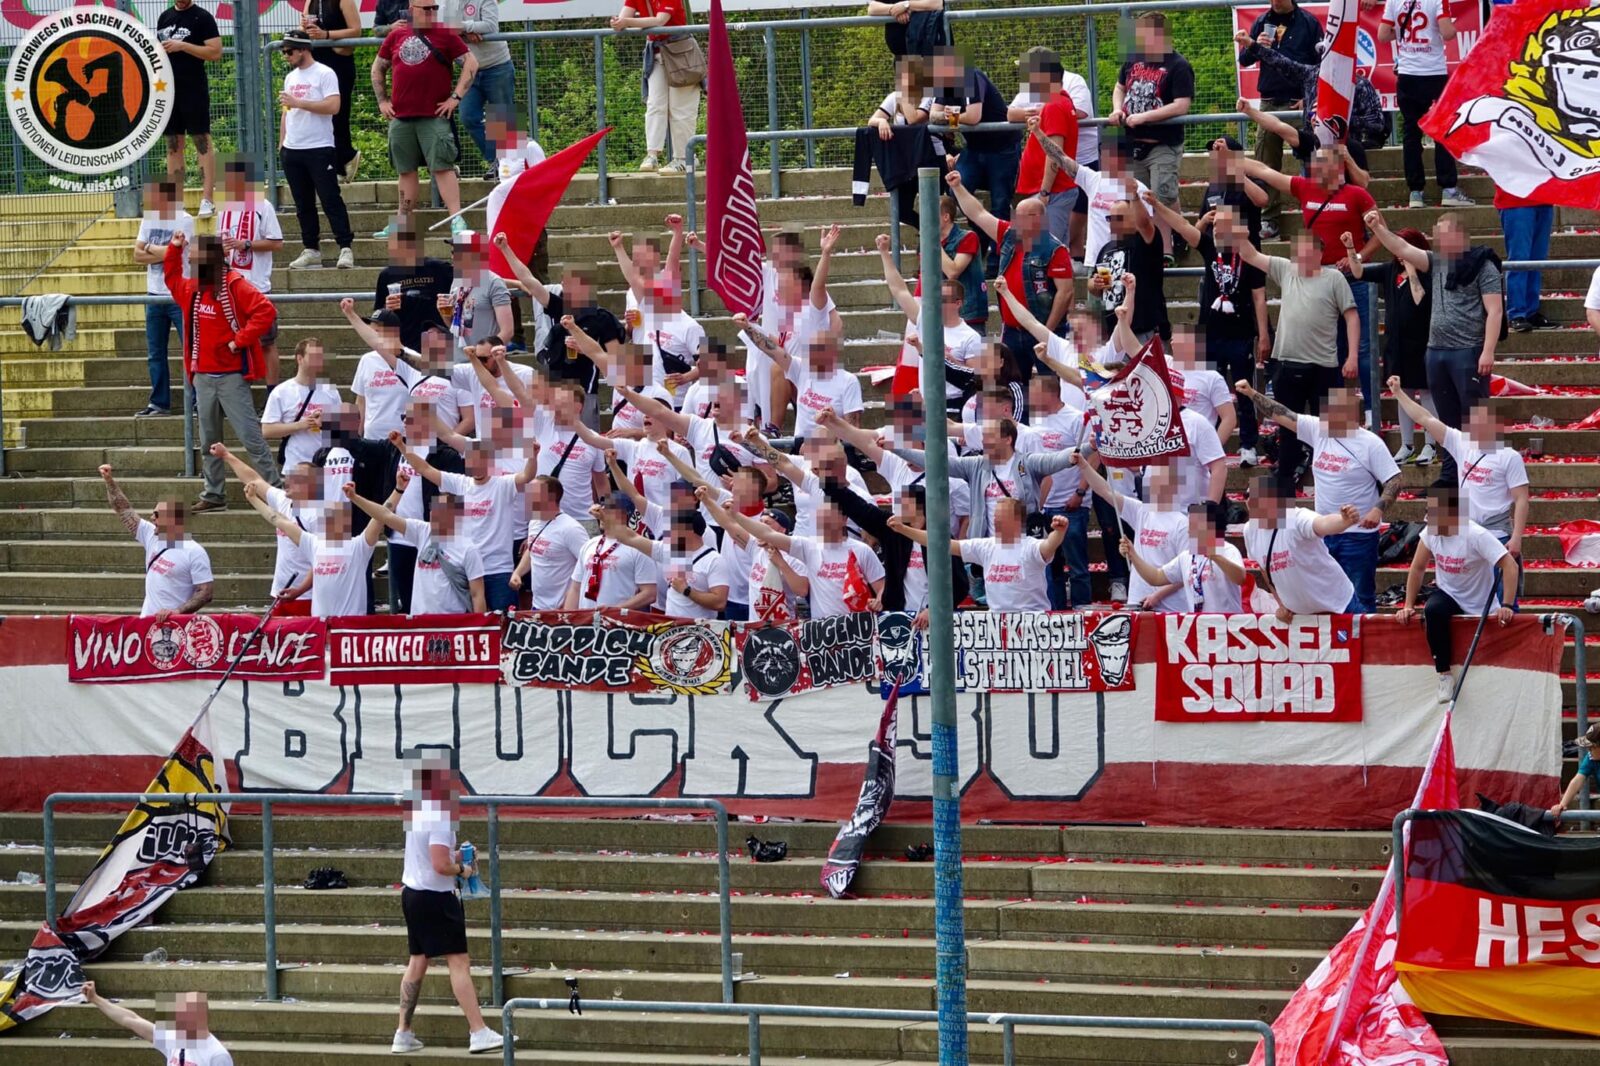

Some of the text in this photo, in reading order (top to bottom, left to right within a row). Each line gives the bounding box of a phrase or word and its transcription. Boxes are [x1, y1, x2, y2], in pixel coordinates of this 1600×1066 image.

[74, 624, 142, 671] VINO
[341, 634, 490, 664] ALIANCO 913
[504, 621, 656, 657] HUDDICH
[801, 611, 874, 653] JUGEND
[922, 612, 1089, 651] SSEN KASSEL
[1165, 613, 1350, 664] KASSEL
[515, 651, 632, 686] BANDE
[808, 644, 876, 687] BANDE
[921, 651, 1088, 690] LSTEIN KIEL
[1182, 663, 1335, 714] SQUAD
[235, 682, 818, 799] BLOCK
[1475, 897, 1600, 968] HES
